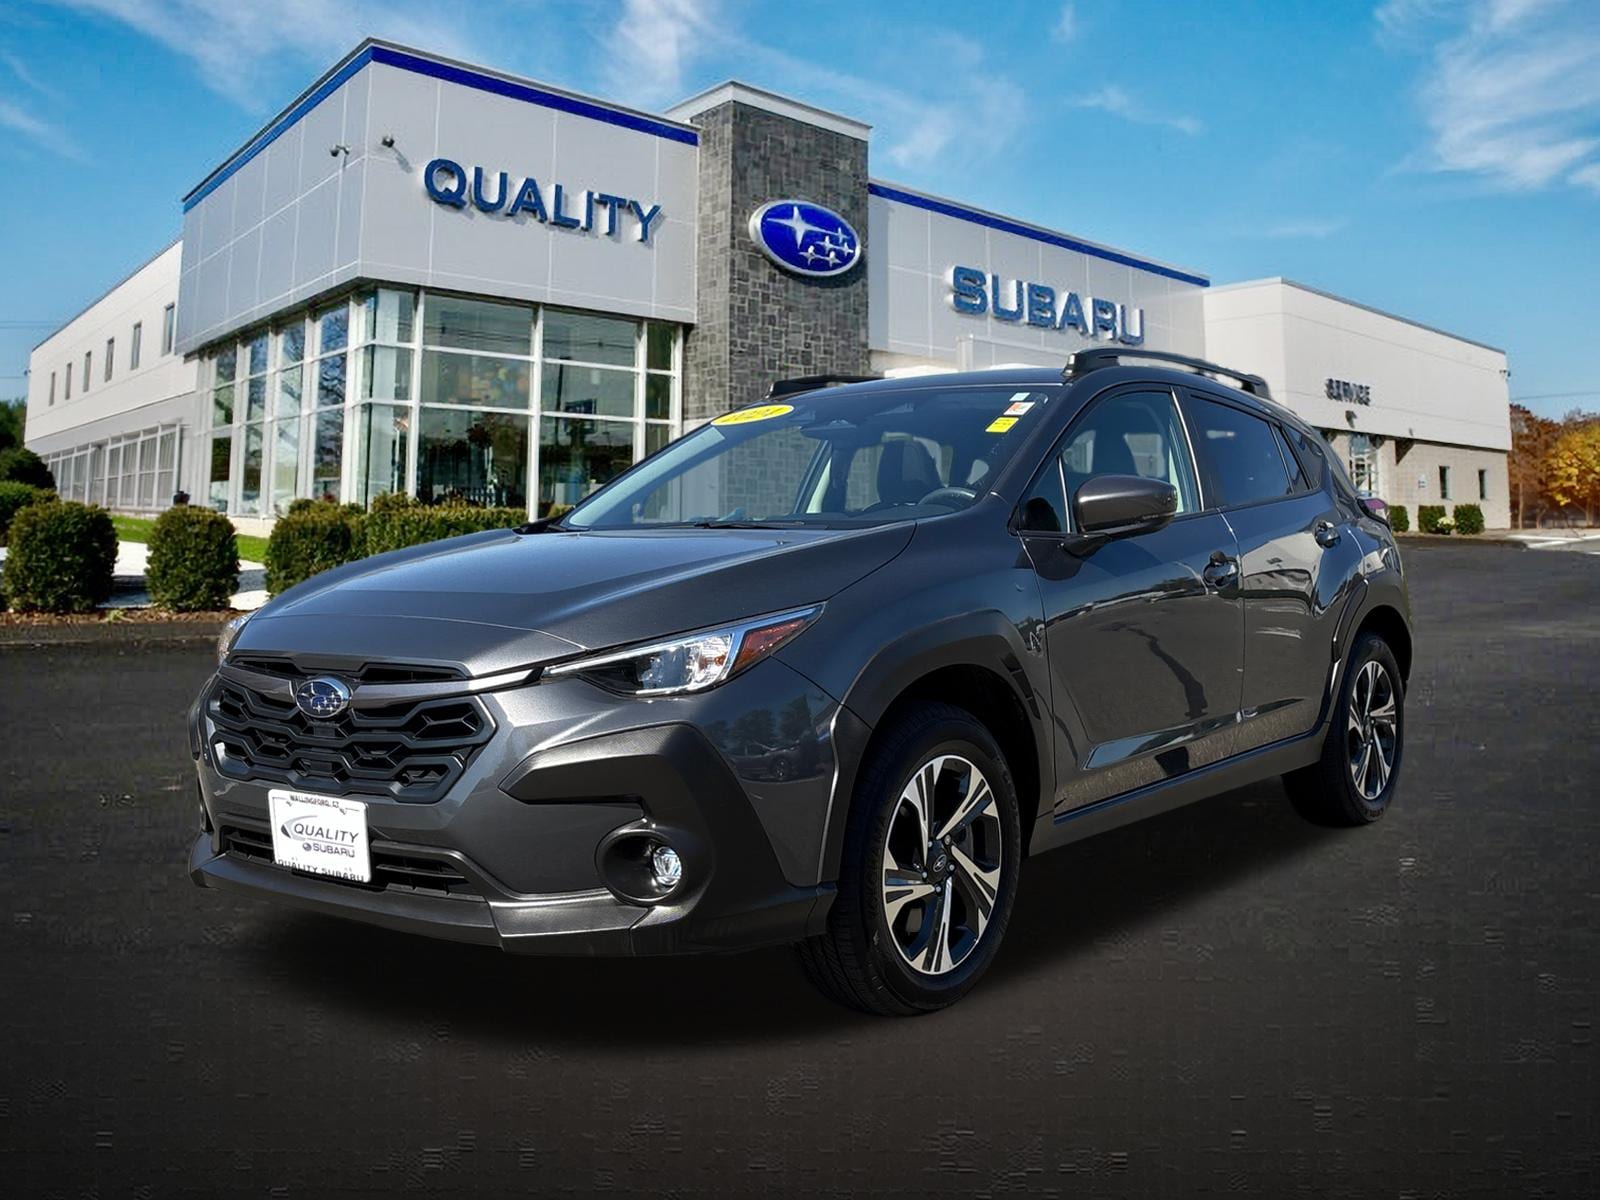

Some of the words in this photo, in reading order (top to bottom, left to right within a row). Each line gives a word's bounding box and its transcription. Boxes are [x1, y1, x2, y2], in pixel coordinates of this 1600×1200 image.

[423, 158, 662, 242] QUALITY
[952, 265, 1145, 345] SUBARU
[1325, 378, 1371, 407] SERVICE
[293, 823, 359, 843] QUALITY
[312, 843, 356, 858] SUBARU
[278, 859, 318, 872] QUALITY
[321, 868, 364, 882] SUBARU
